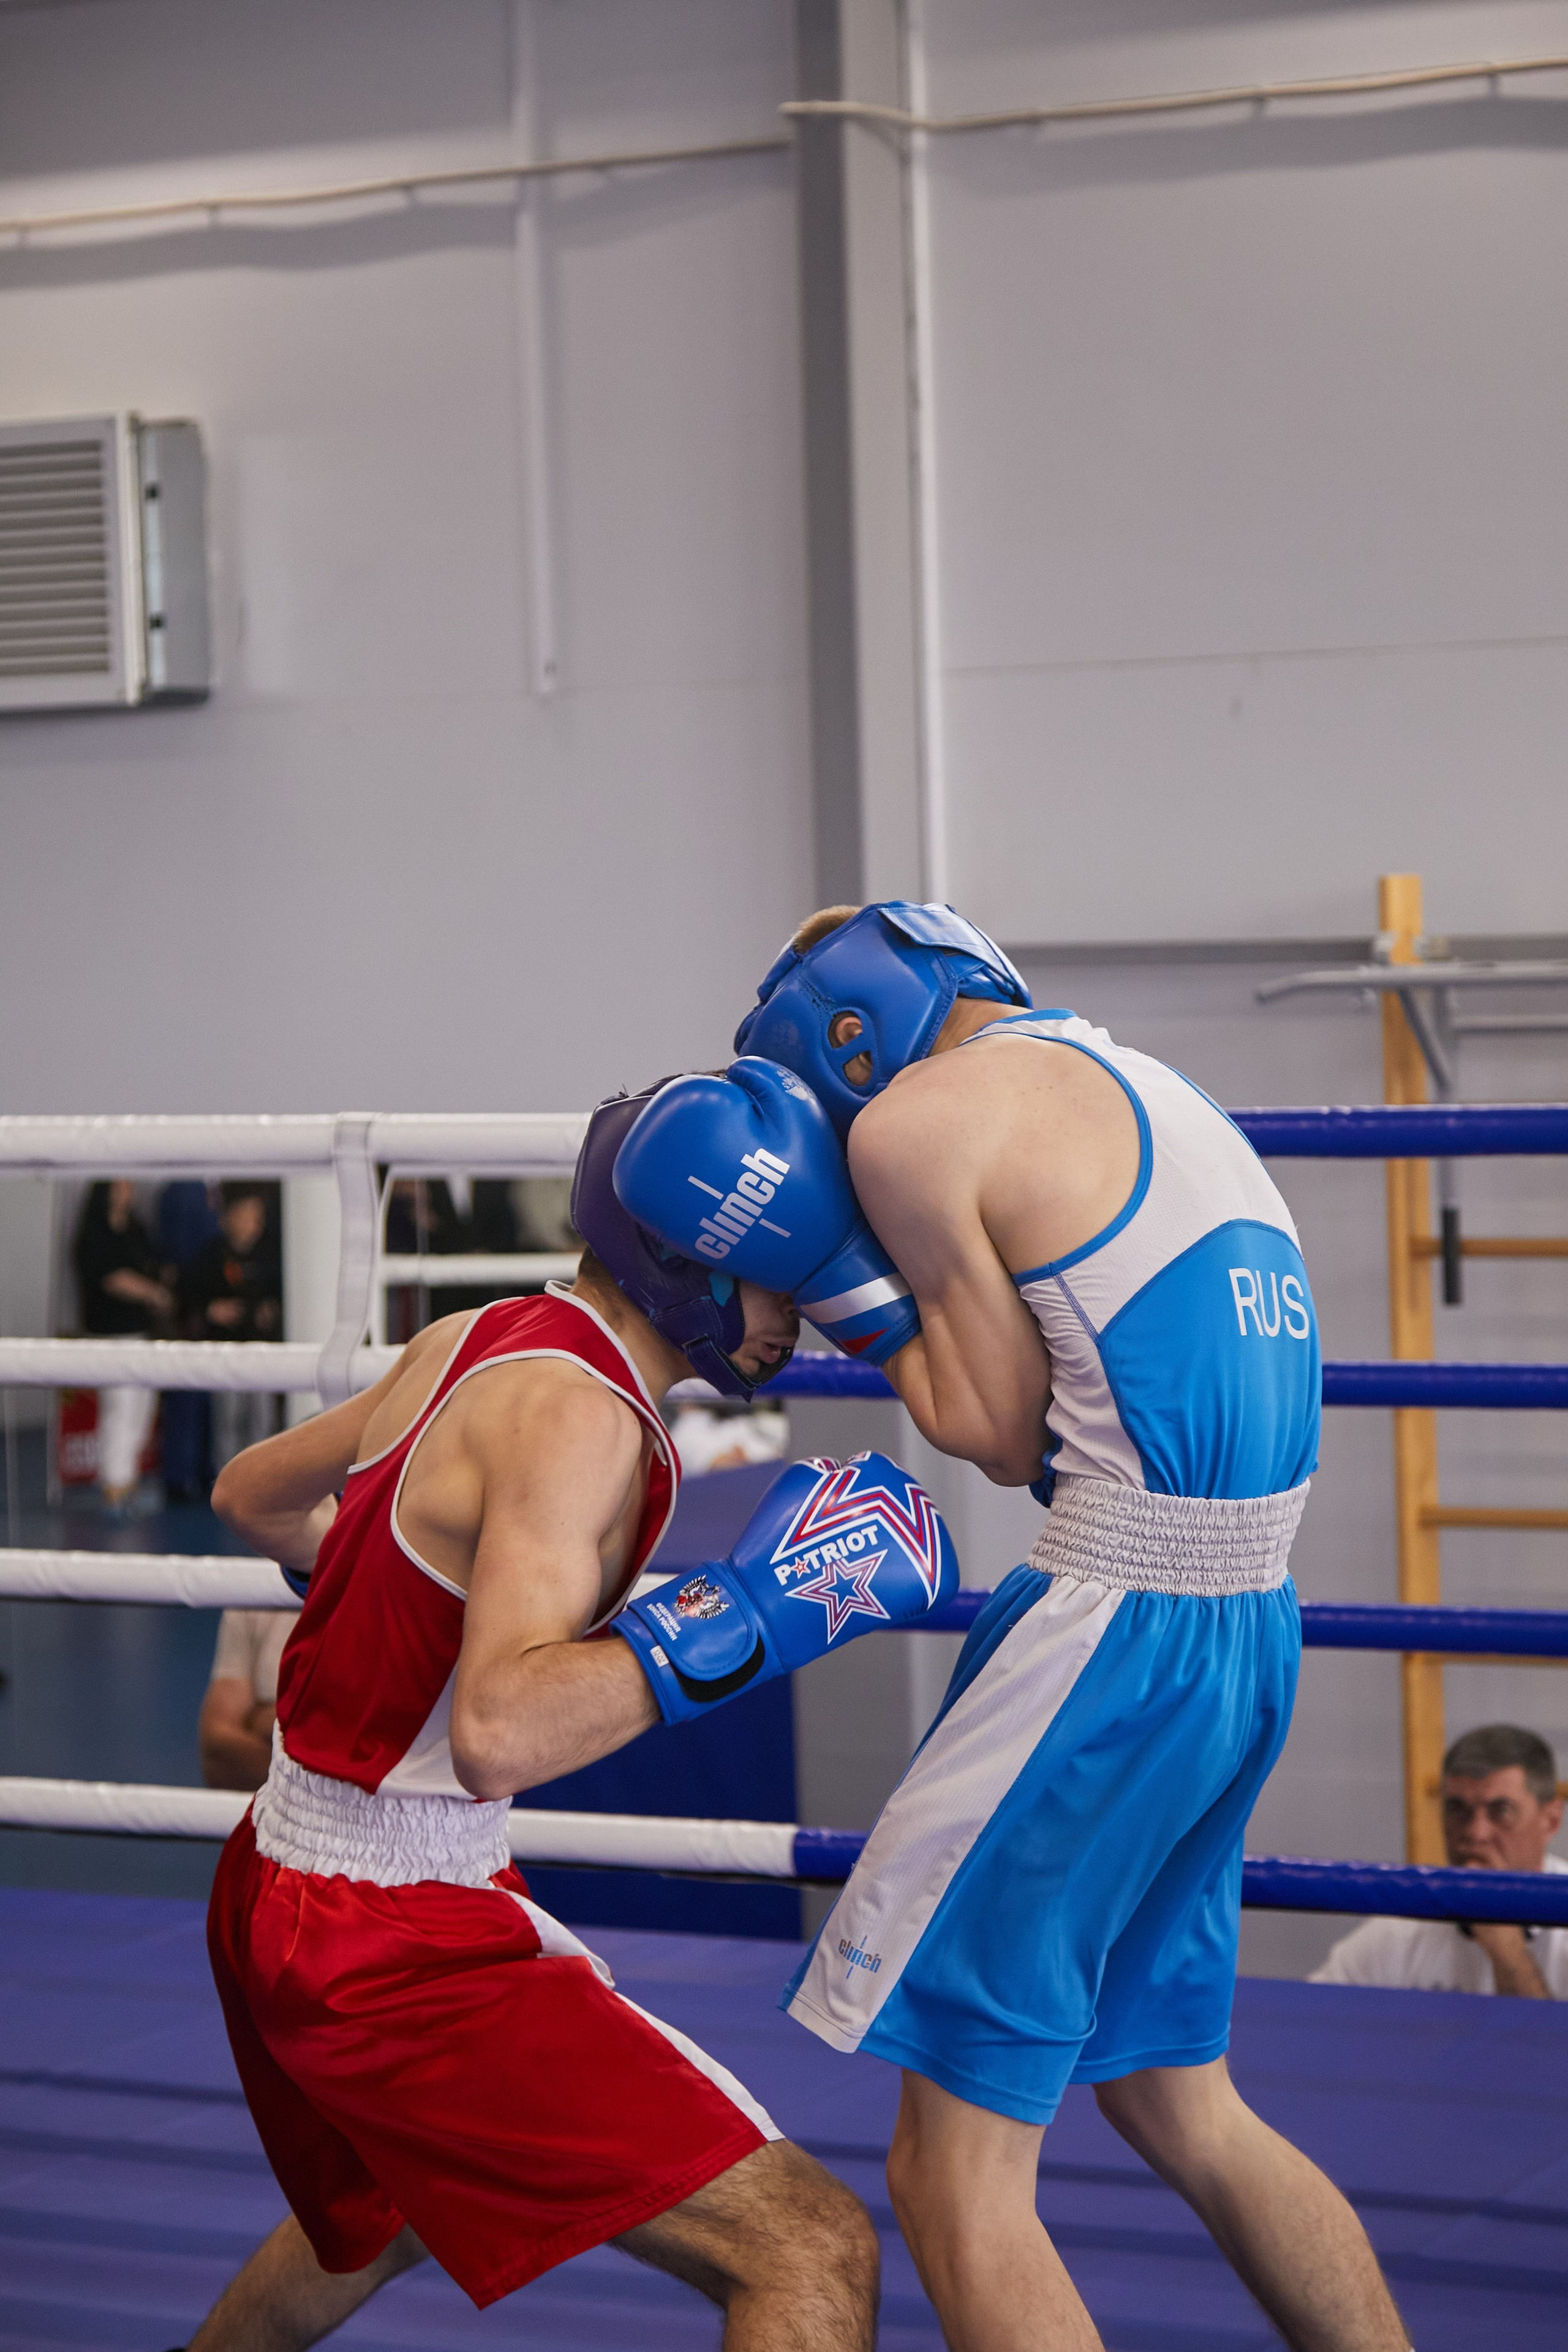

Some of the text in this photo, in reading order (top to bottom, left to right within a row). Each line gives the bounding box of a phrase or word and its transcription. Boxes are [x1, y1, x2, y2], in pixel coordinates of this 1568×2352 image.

[695, 1148, 790, 1259] clinch
[1228, 1268, 1309, 1340] RUS
[656, 1602, 681, 1633] ФЕДЕРАЦИЯ
[658, 1616, 677, 1641] РОССИИ
[839, 1939, 882, 1973] clinch
